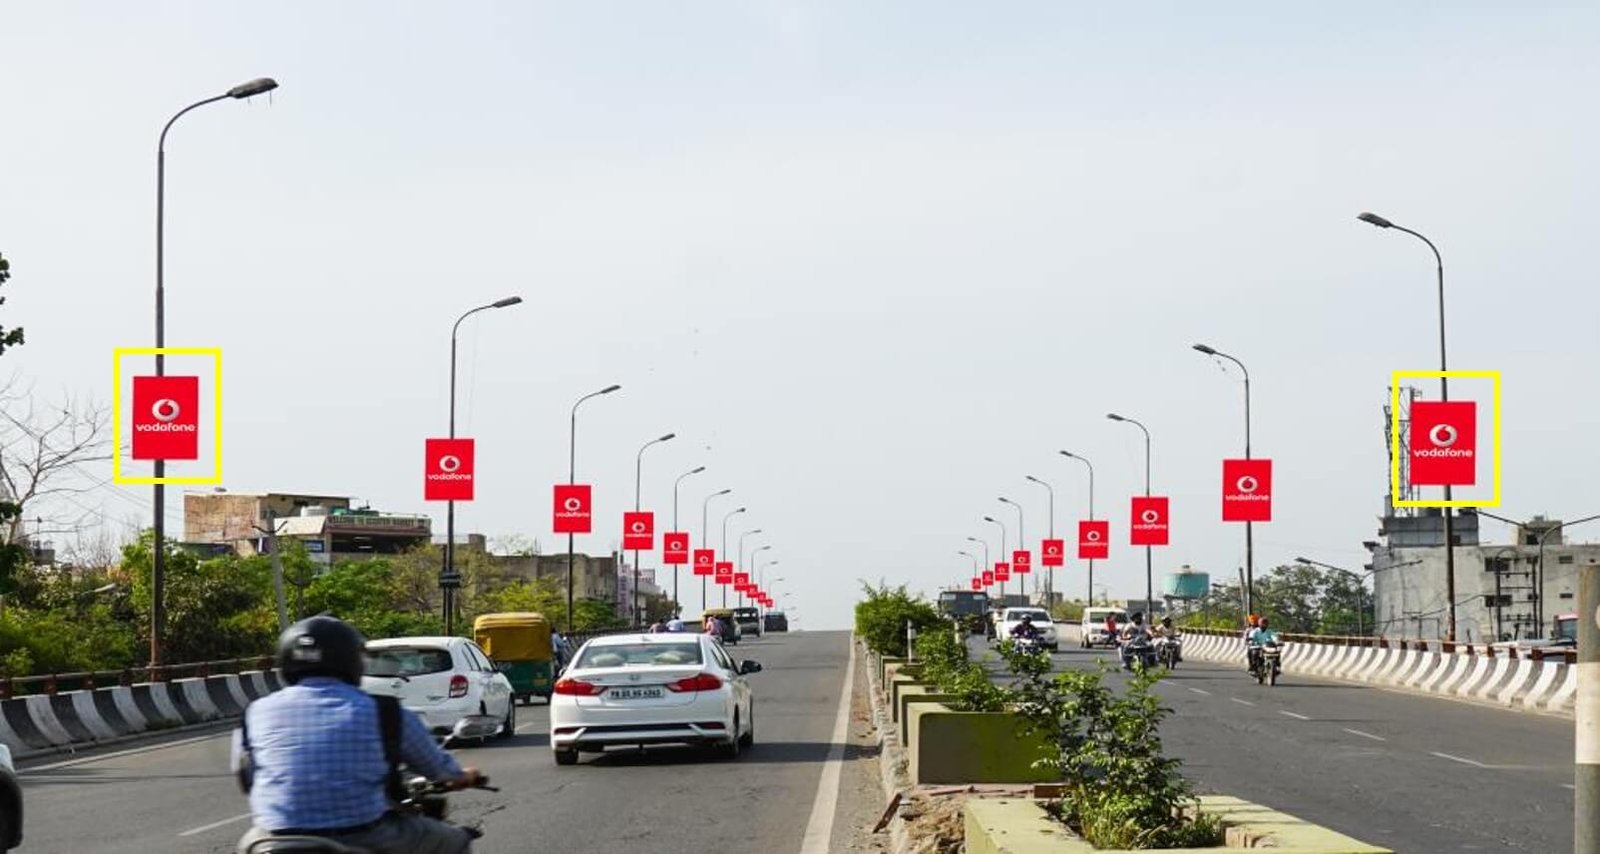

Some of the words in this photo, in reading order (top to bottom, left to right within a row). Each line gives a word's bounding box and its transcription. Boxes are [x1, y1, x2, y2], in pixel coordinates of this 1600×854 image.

[135, 422, 196, 432] vodafone
[1413, 447, 1473, 457] vodafone
[427, 472, 471, 481] vodafone
[1225, 493, 1269, 502] vodafone
